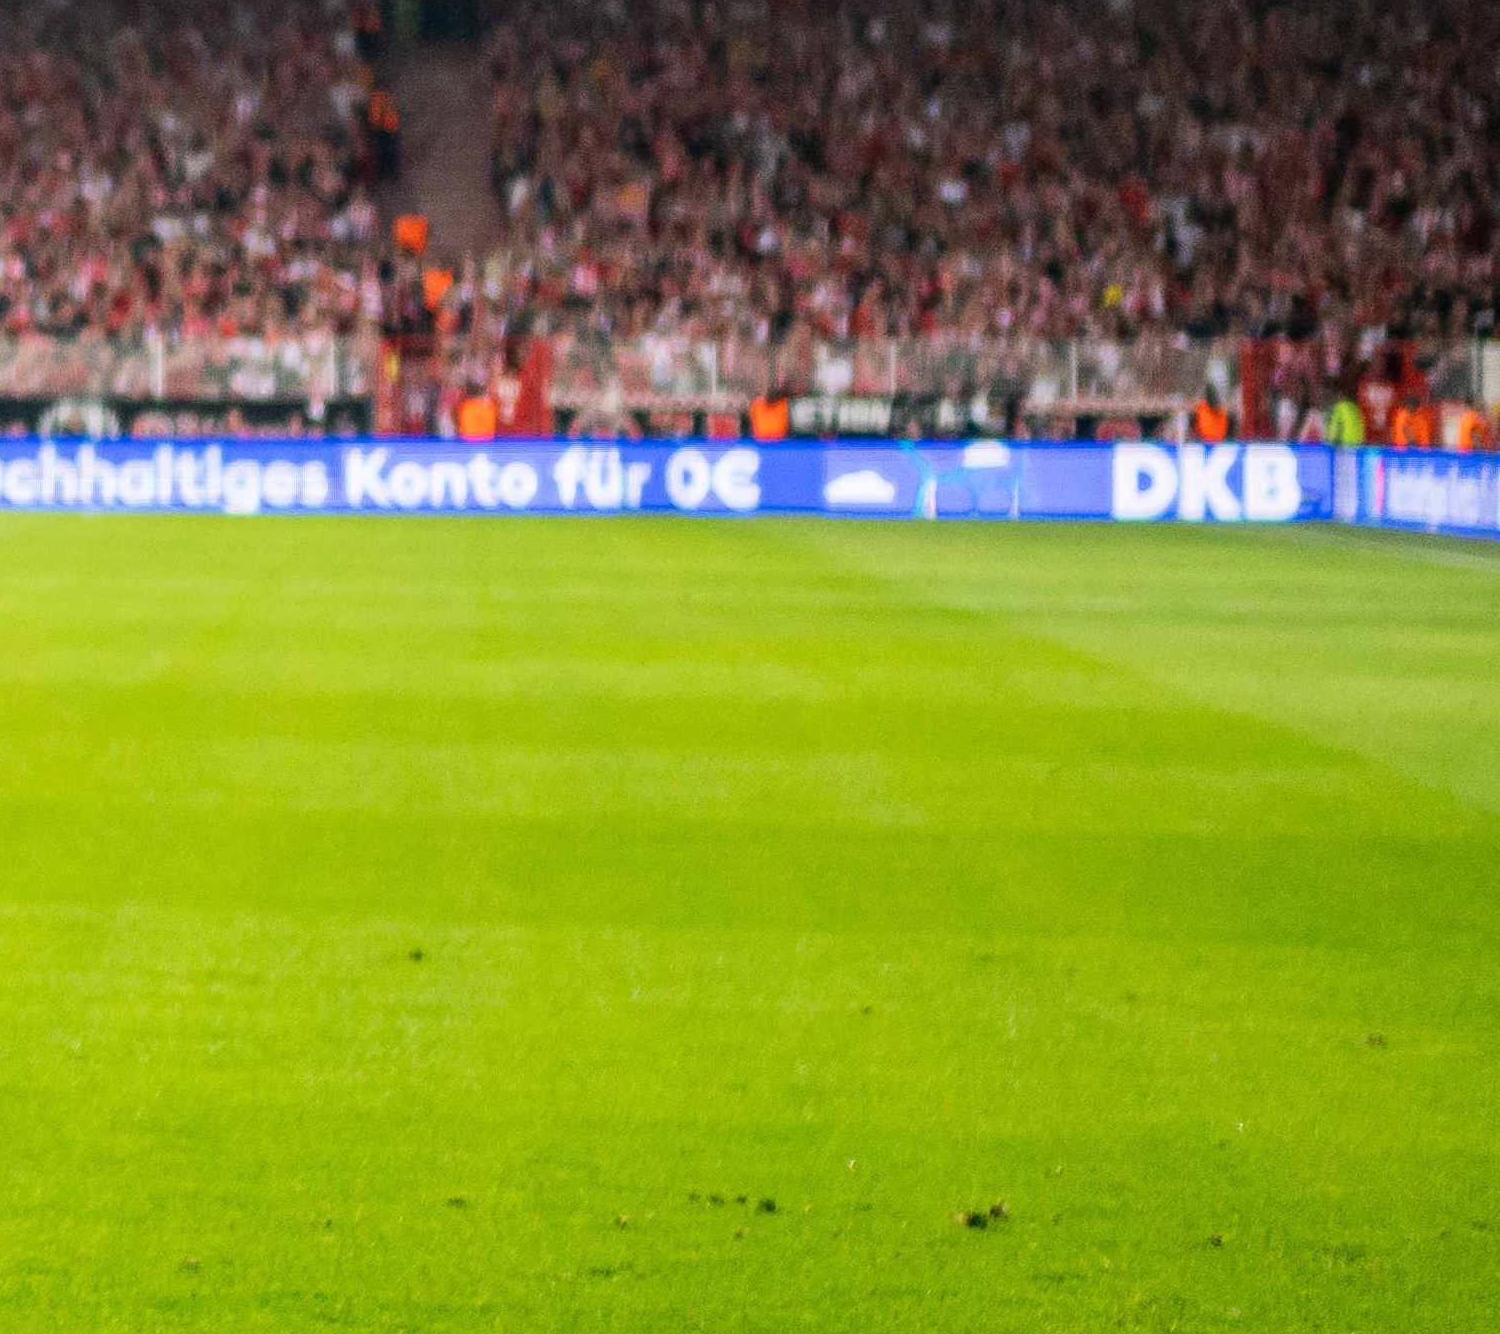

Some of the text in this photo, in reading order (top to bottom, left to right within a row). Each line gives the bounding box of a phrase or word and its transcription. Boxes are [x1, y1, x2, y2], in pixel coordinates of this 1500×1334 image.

[345, 445, 538, 509] Konto
[555, 444, 645, 509] für
[1111, 443, 1301, 522] DKB
